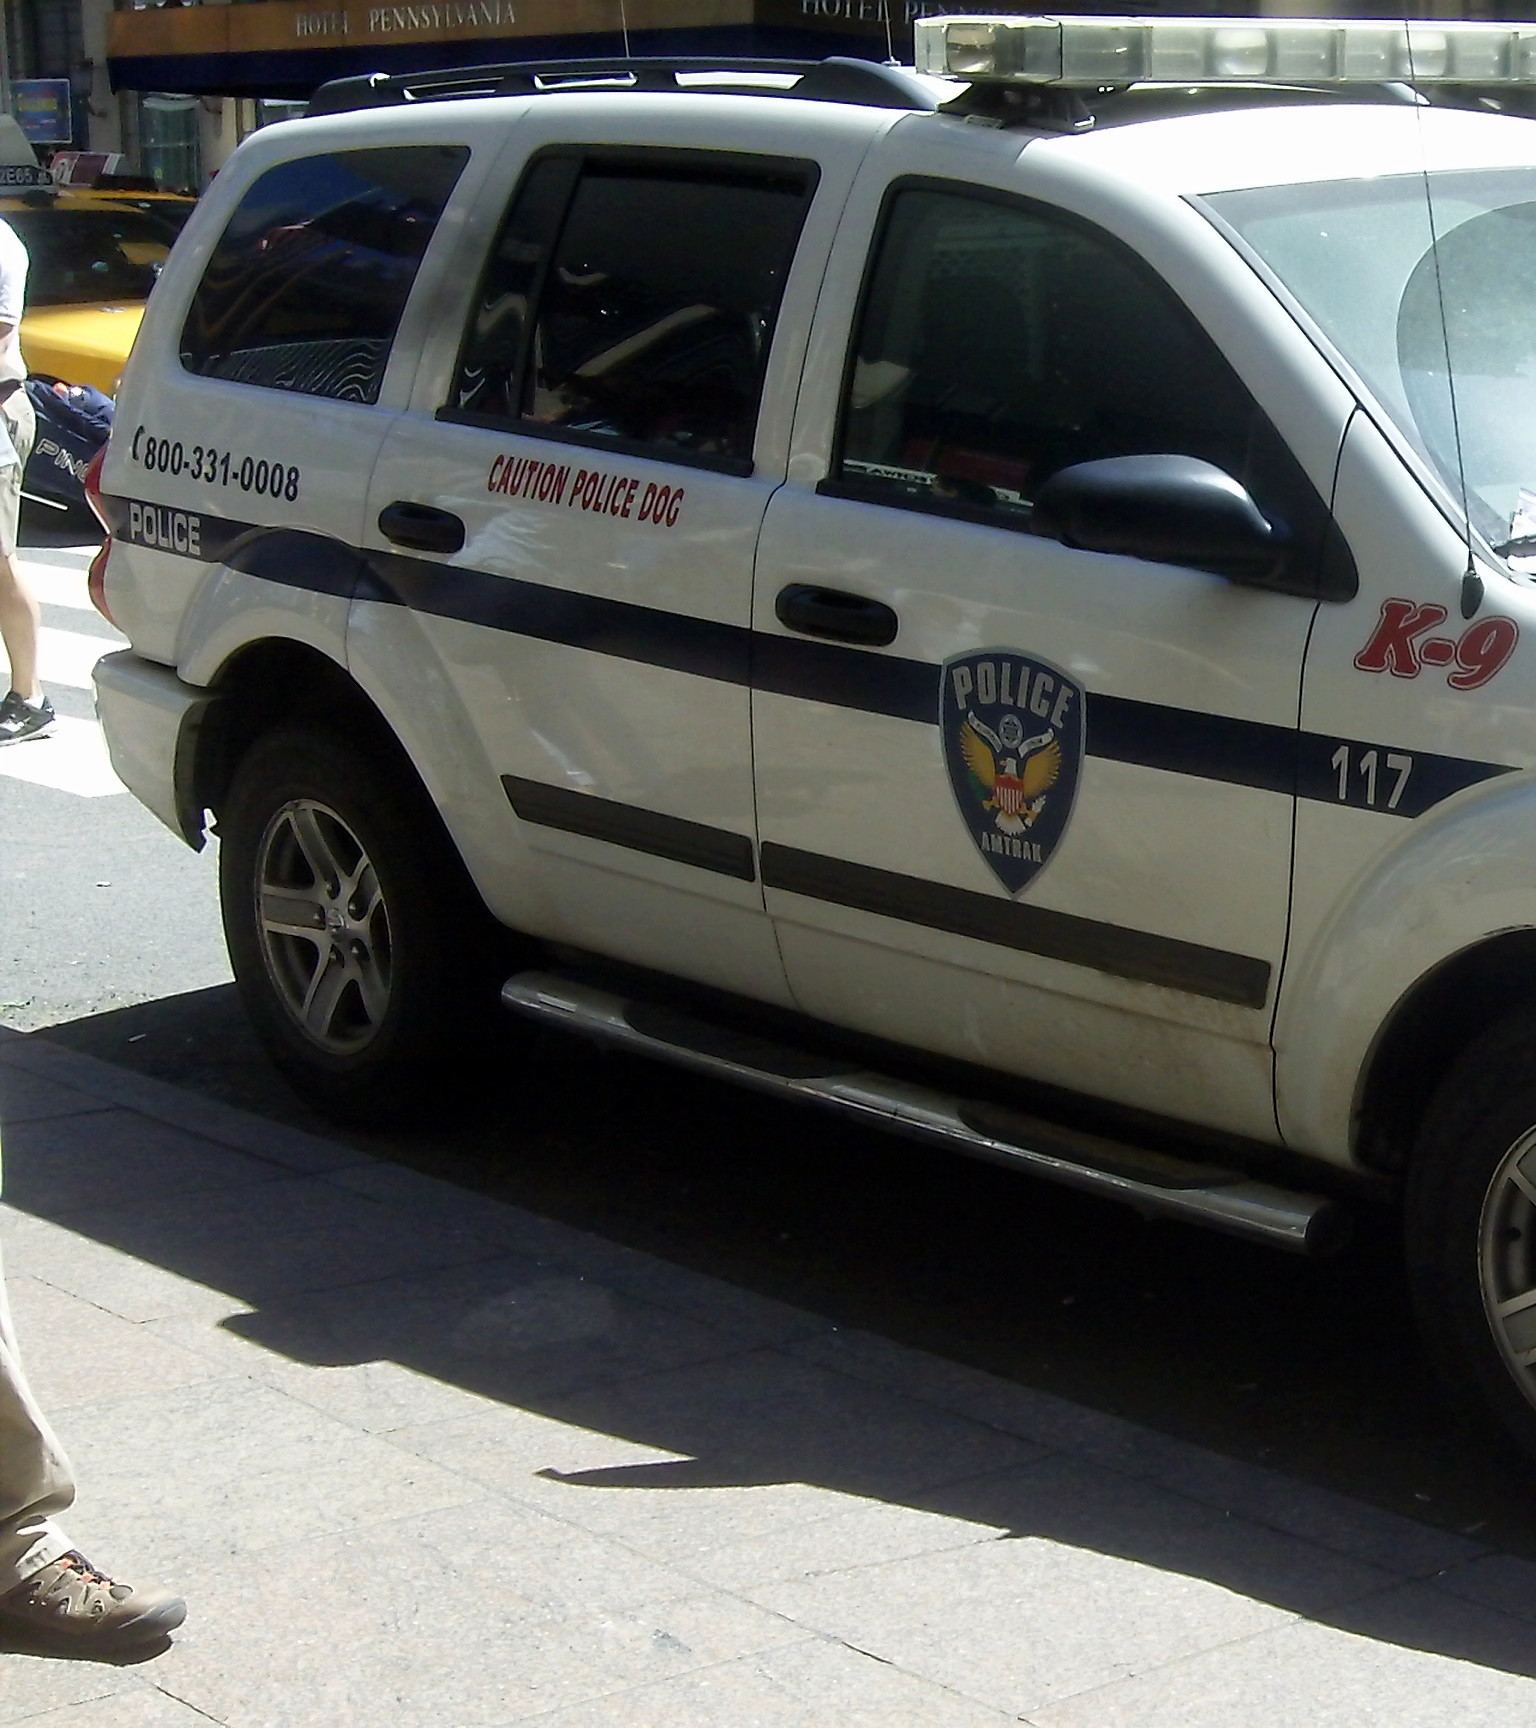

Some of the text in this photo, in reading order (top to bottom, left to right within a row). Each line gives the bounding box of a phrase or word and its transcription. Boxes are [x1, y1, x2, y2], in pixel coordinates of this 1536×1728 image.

[369, 2, 516, 32] PENNSYLVANIA
[145, 437, 299, 502] 800-331-0008
[488, 454, 685, 527] CAUTION POLICE DOG
[129, 502, 201, 556] POLICE
[1352, 597, 1519, 691] K-9
[952, 662, 1074, 729] POLICE
[1331, 744, 1416, 809] 117
[981, 831, 1043, 863] AMTRAK
